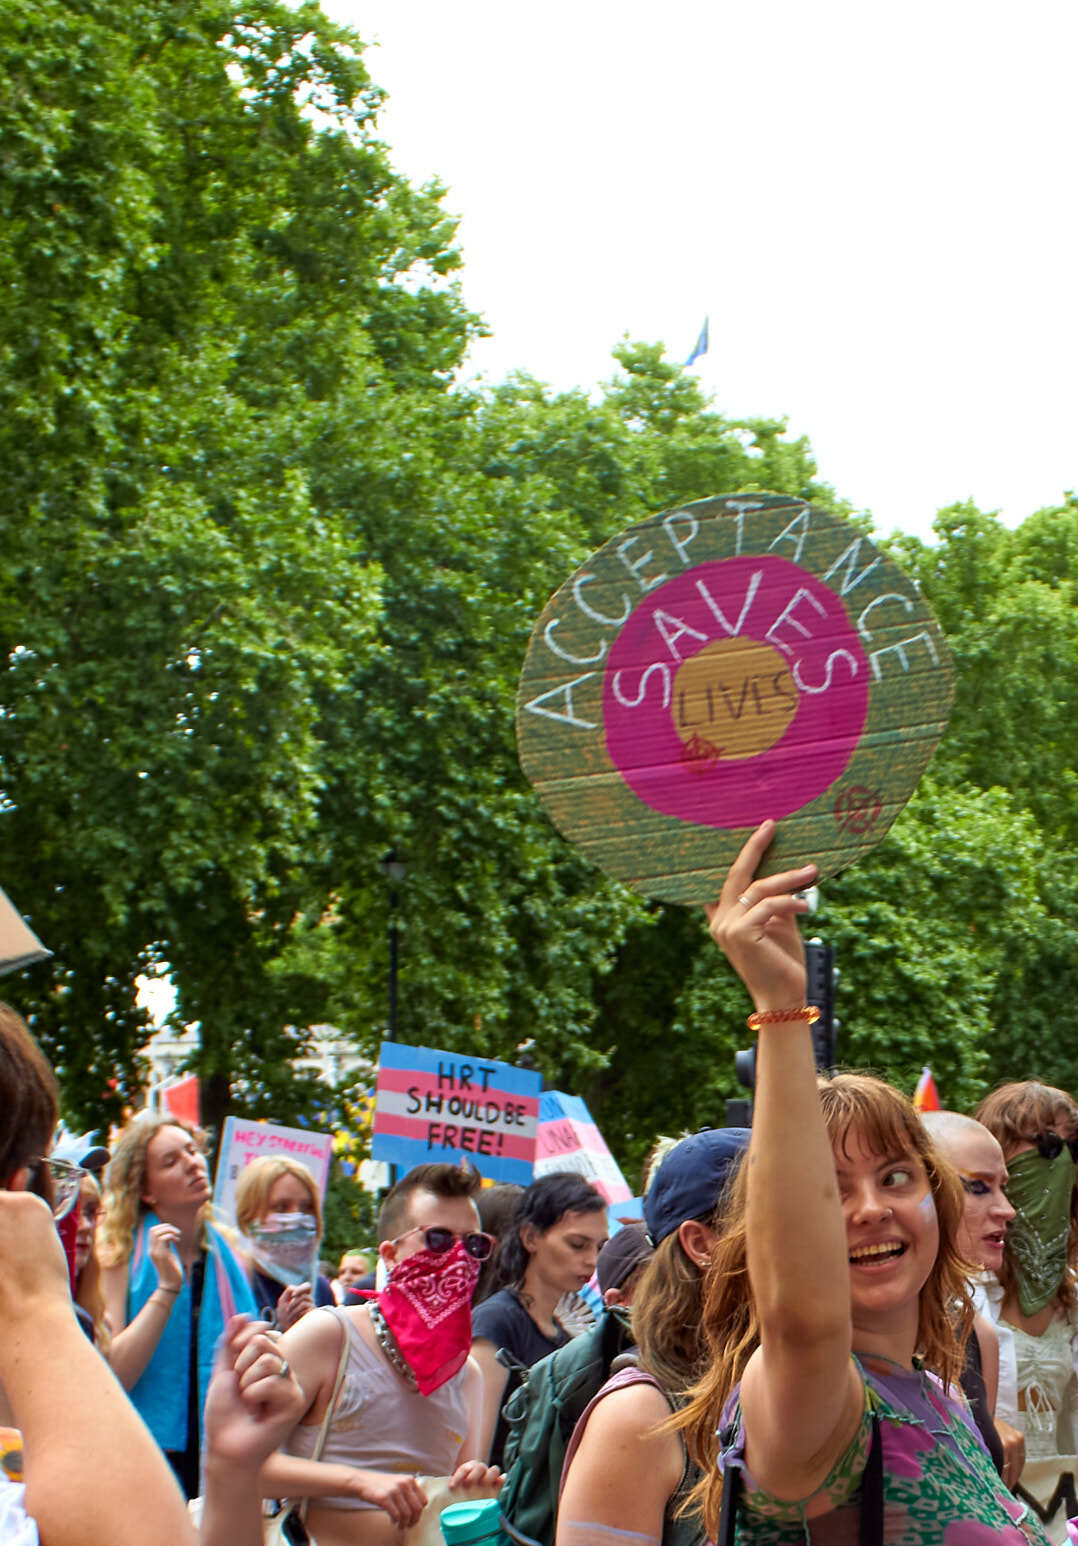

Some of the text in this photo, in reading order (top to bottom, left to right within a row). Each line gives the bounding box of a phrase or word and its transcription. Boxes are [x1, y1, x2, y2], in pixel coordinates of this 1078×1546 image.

[523, 499, 940, 730] ACCEPTANCE
[611, 569, 859, 710] SAVES
[676, 670, 799, 728] LIVES
[437, 1060, 497, 1093] HRT
[406, 1086, 500, 1124] SHOULD
[503, 1101, 528, 1127] BE
[426, 1122, 505, 1157] FREE!
